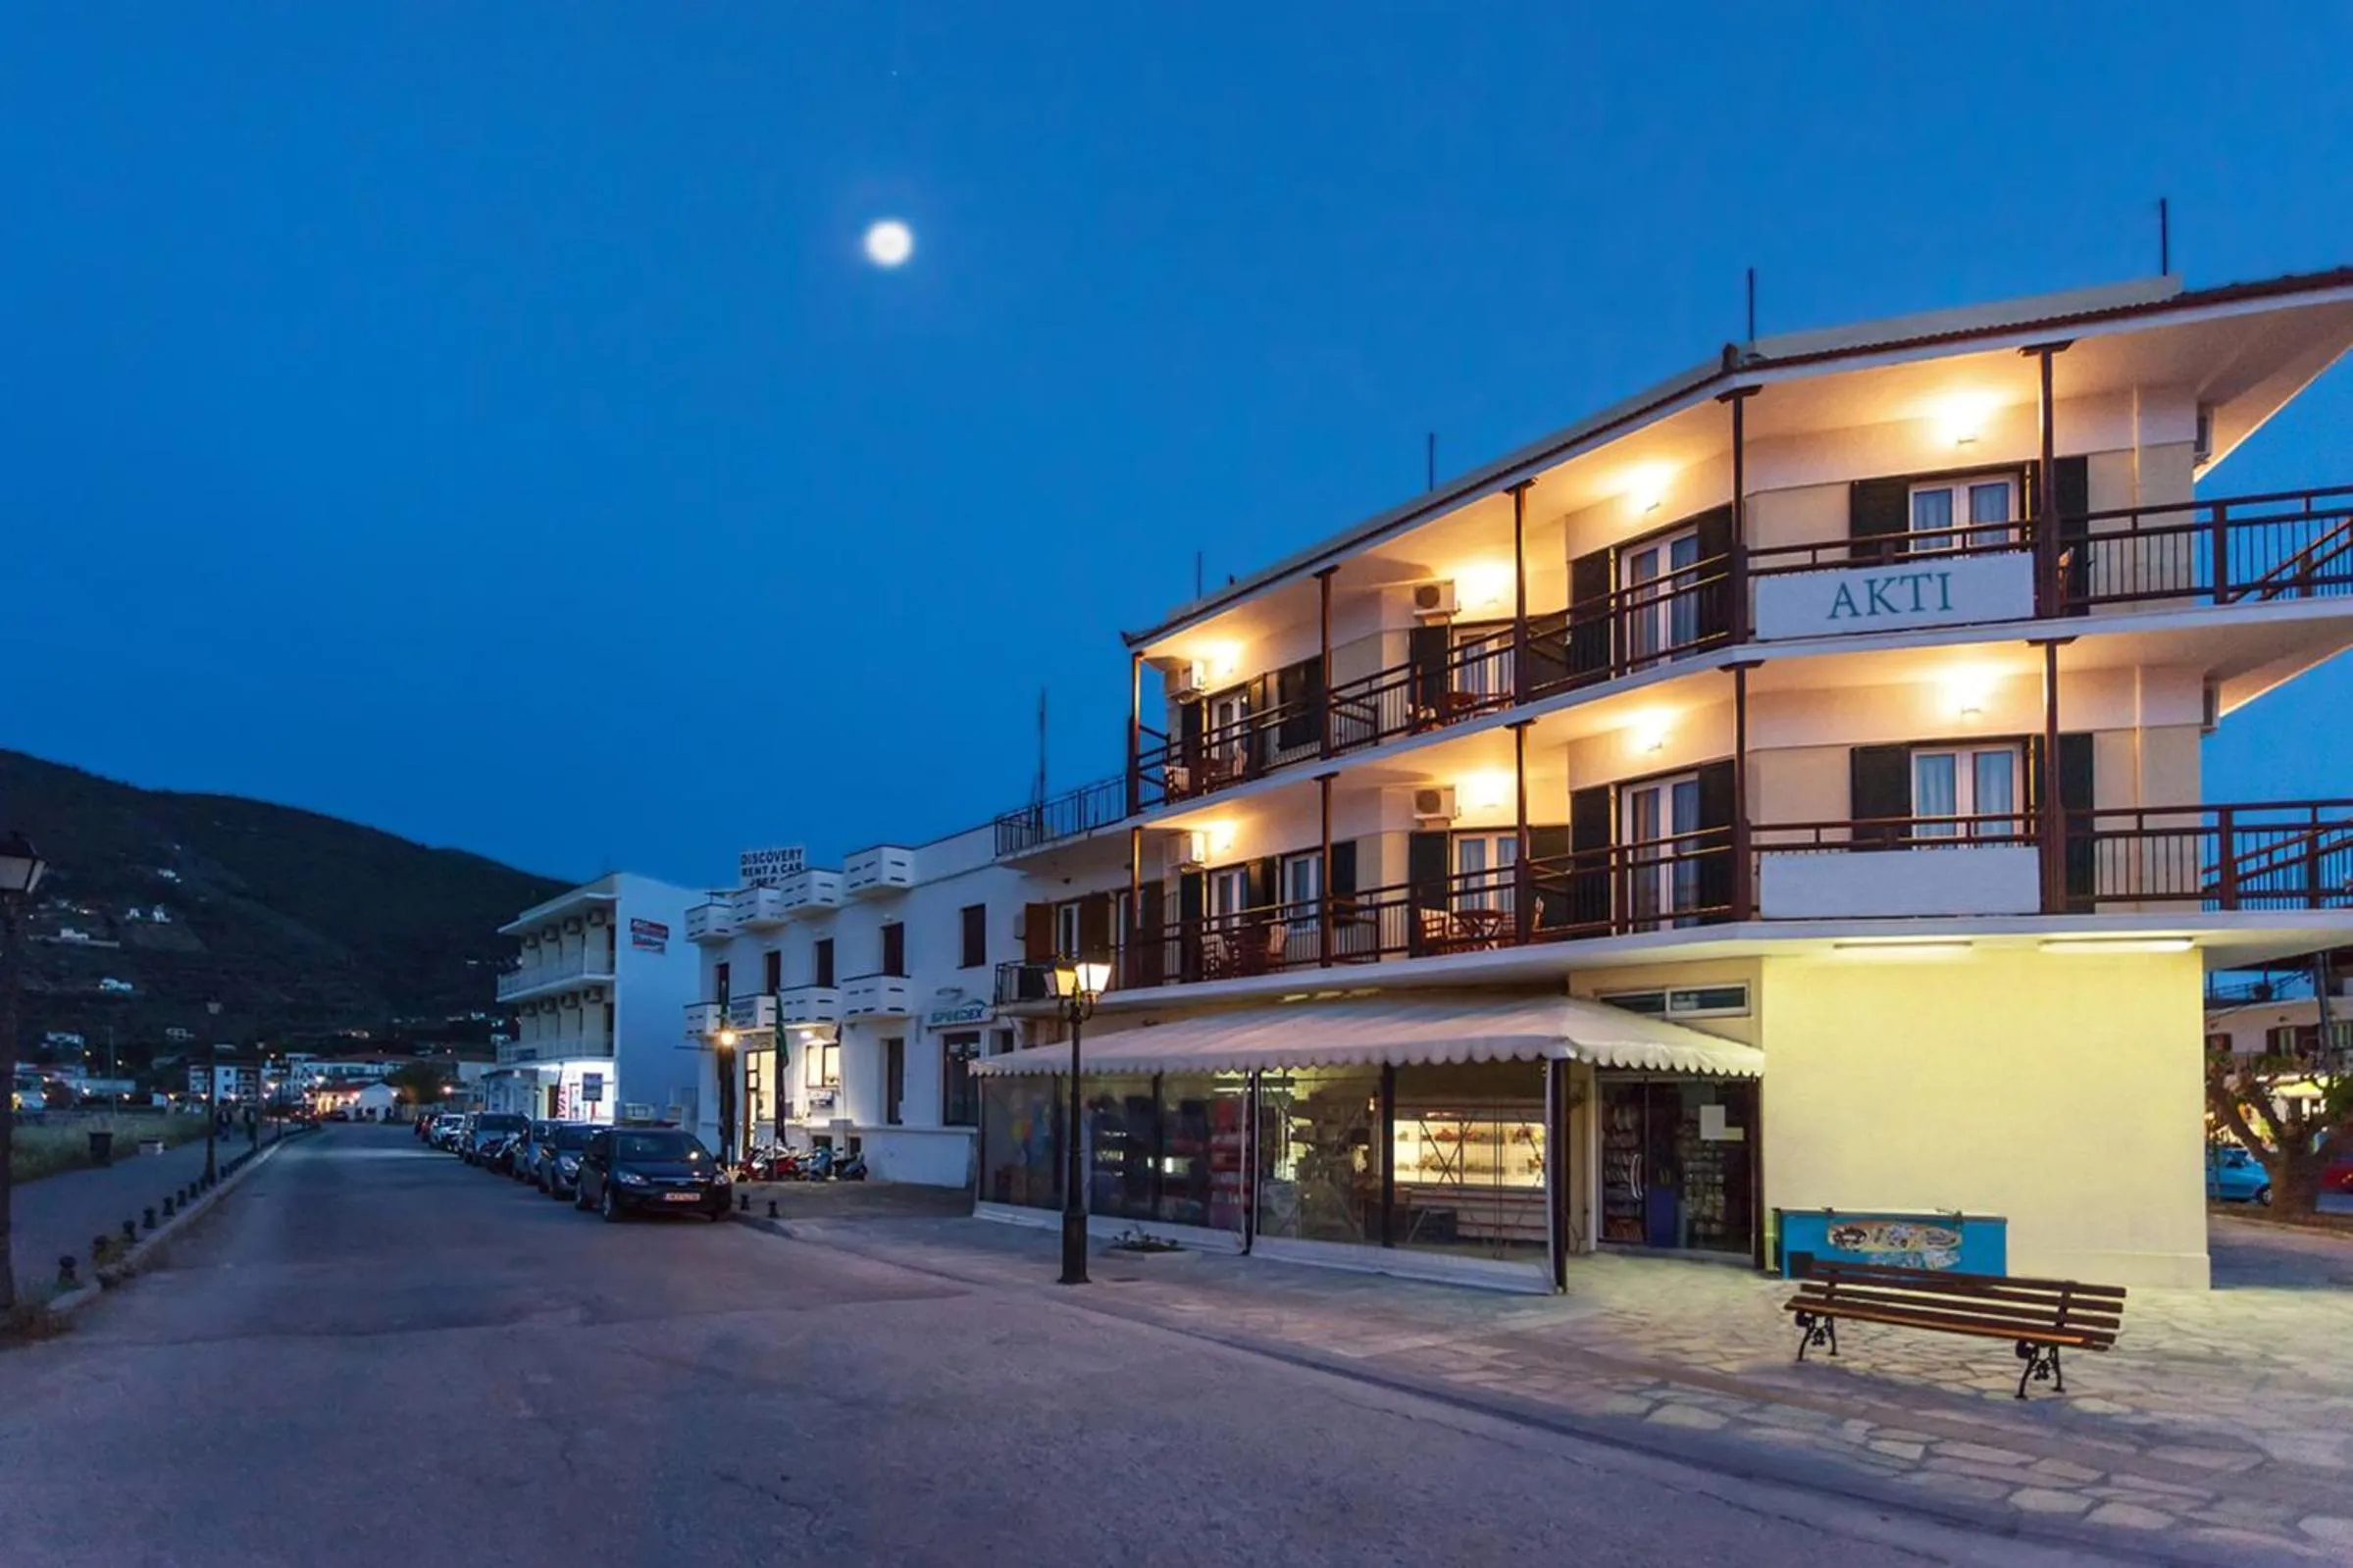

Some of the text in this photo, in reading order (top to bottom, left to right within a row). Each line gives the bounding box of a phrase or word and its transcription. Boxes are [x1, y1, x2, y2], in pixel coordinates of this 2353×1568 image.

[1826, 572, 1954, 620] AKTI
[741, 848, 803, 865] DISCOVERY
[742, 862, 803, 877] RENT A CAR
